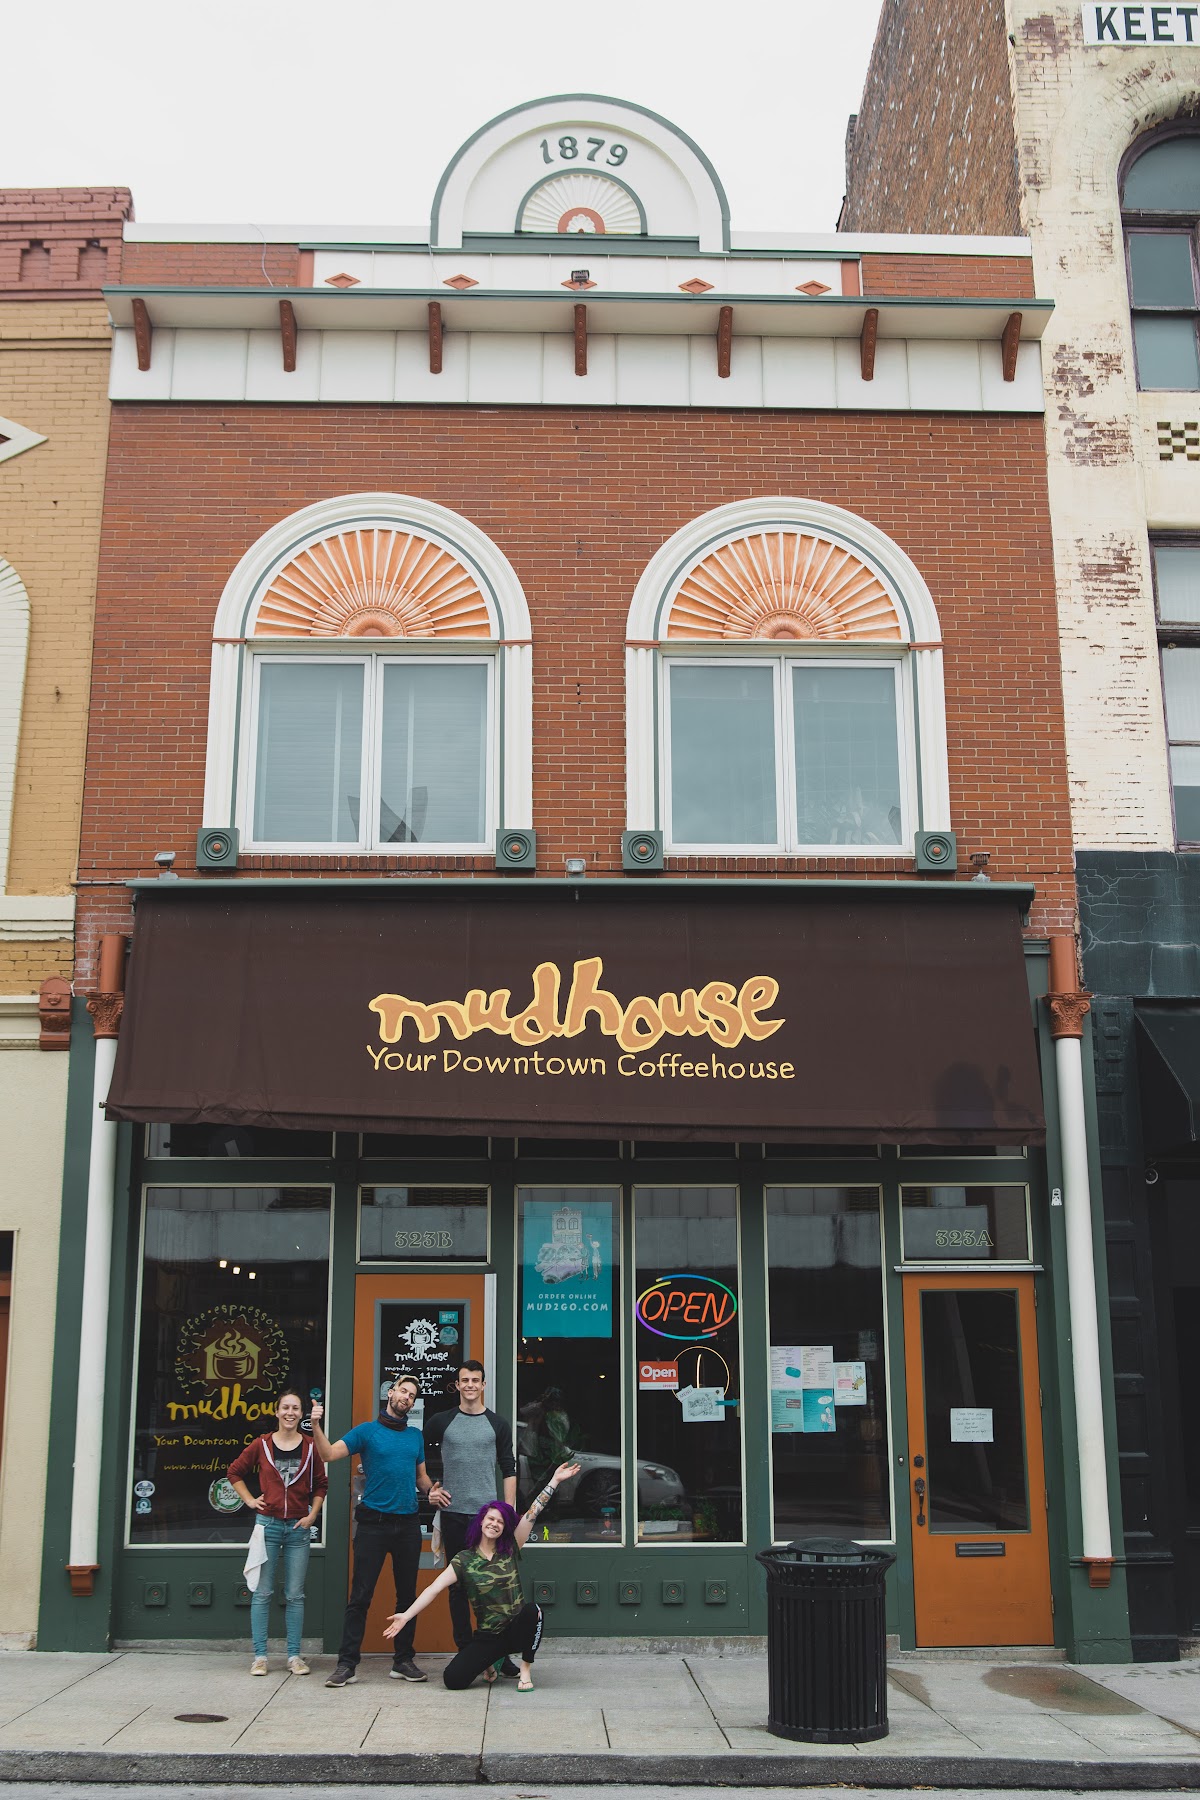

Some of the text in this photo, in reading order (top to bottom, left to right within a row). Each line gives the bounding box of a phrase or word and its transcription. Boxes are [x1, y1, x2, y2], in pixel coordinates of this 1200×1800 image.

[1095, 7, 1198, 42] KEET
[540, 136, 628, 166] 1879
[369, 956, 786, 1052] mudhouse
[366, 1045, 795, 1079] Your Downtown Coffeehouse
[394, 1231, 453, 1248] 323B
[935, 1229, 994, 1246] 323A
[526, 1303, 608, 1311] MUD2GO.COM
[641, 1291, 728, 1323] OPEN
[177, 1313, 206, 1352] coffee
[214, 1304, 273, 1325] espresso
[394, 1347, 449, 1361] mudhouse
[385, 1364, 413, 1372] monday
[419, 1372, 442, 1380] 11pm
[641, 1365, 677, 1380] Open
[421, 1388, 443, 1396] 11pm
[166, 1383, 278, 1421] mudhou
[153, 1435, 179, 1446] Your
[183, 1435, 239, 1446] Downtown
